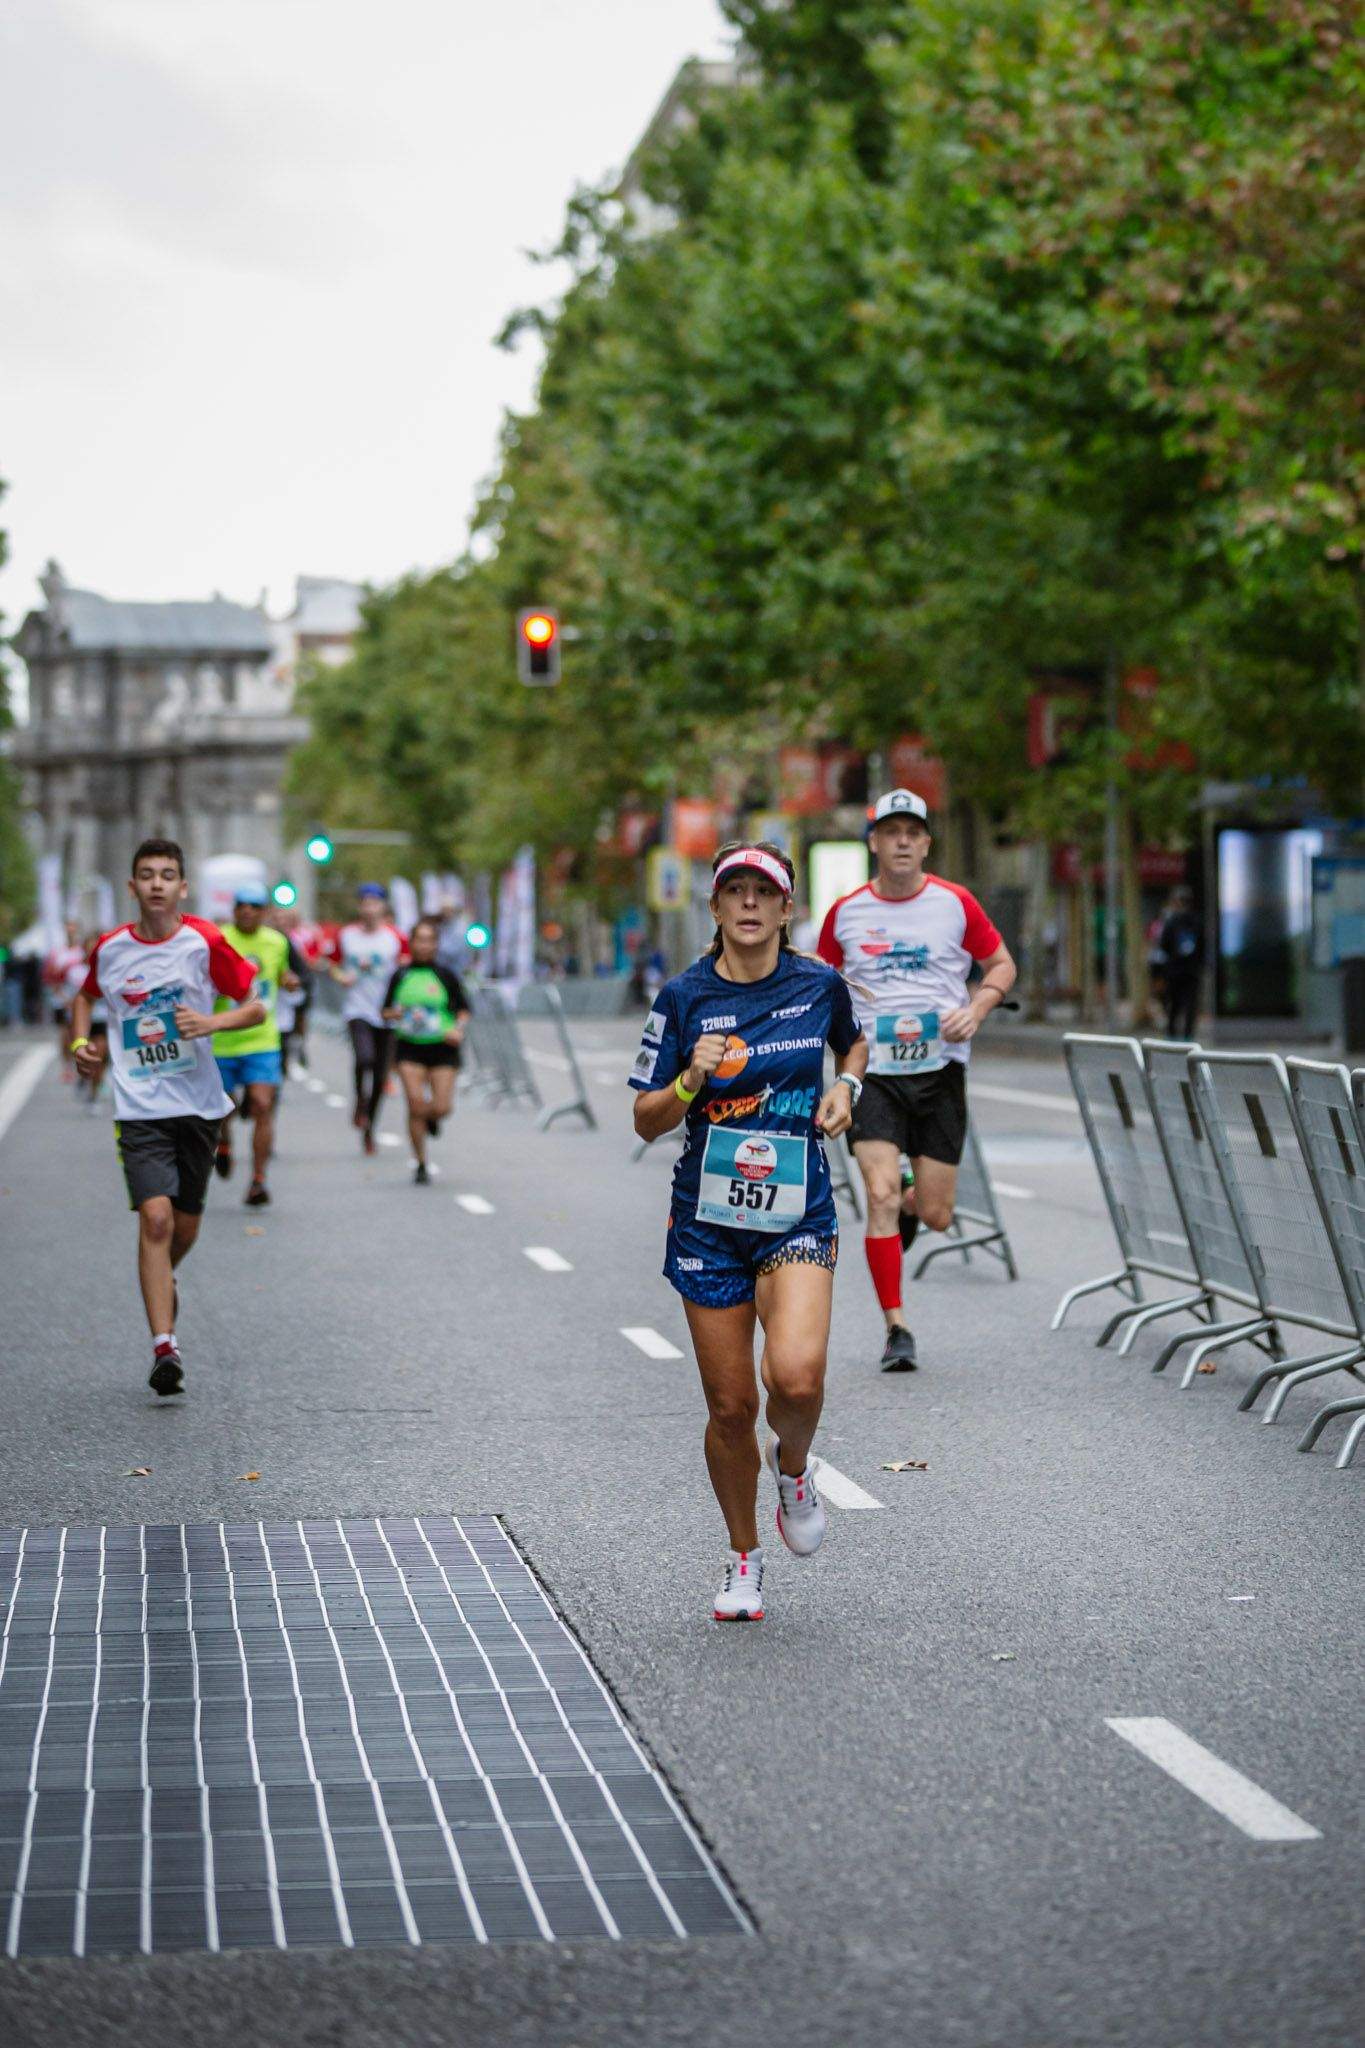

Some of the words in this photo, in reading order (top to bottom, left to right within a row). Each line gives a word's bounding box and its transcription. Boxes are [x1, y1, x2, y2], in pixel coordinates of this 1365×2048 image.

[137, 1041, 179, 1066] 1409
[757, 1037, 823, 1056] ESTUDIANTES
[769, 1086, 815, 1119] LIBRE
[728, 1179, 778, 1212] 557
